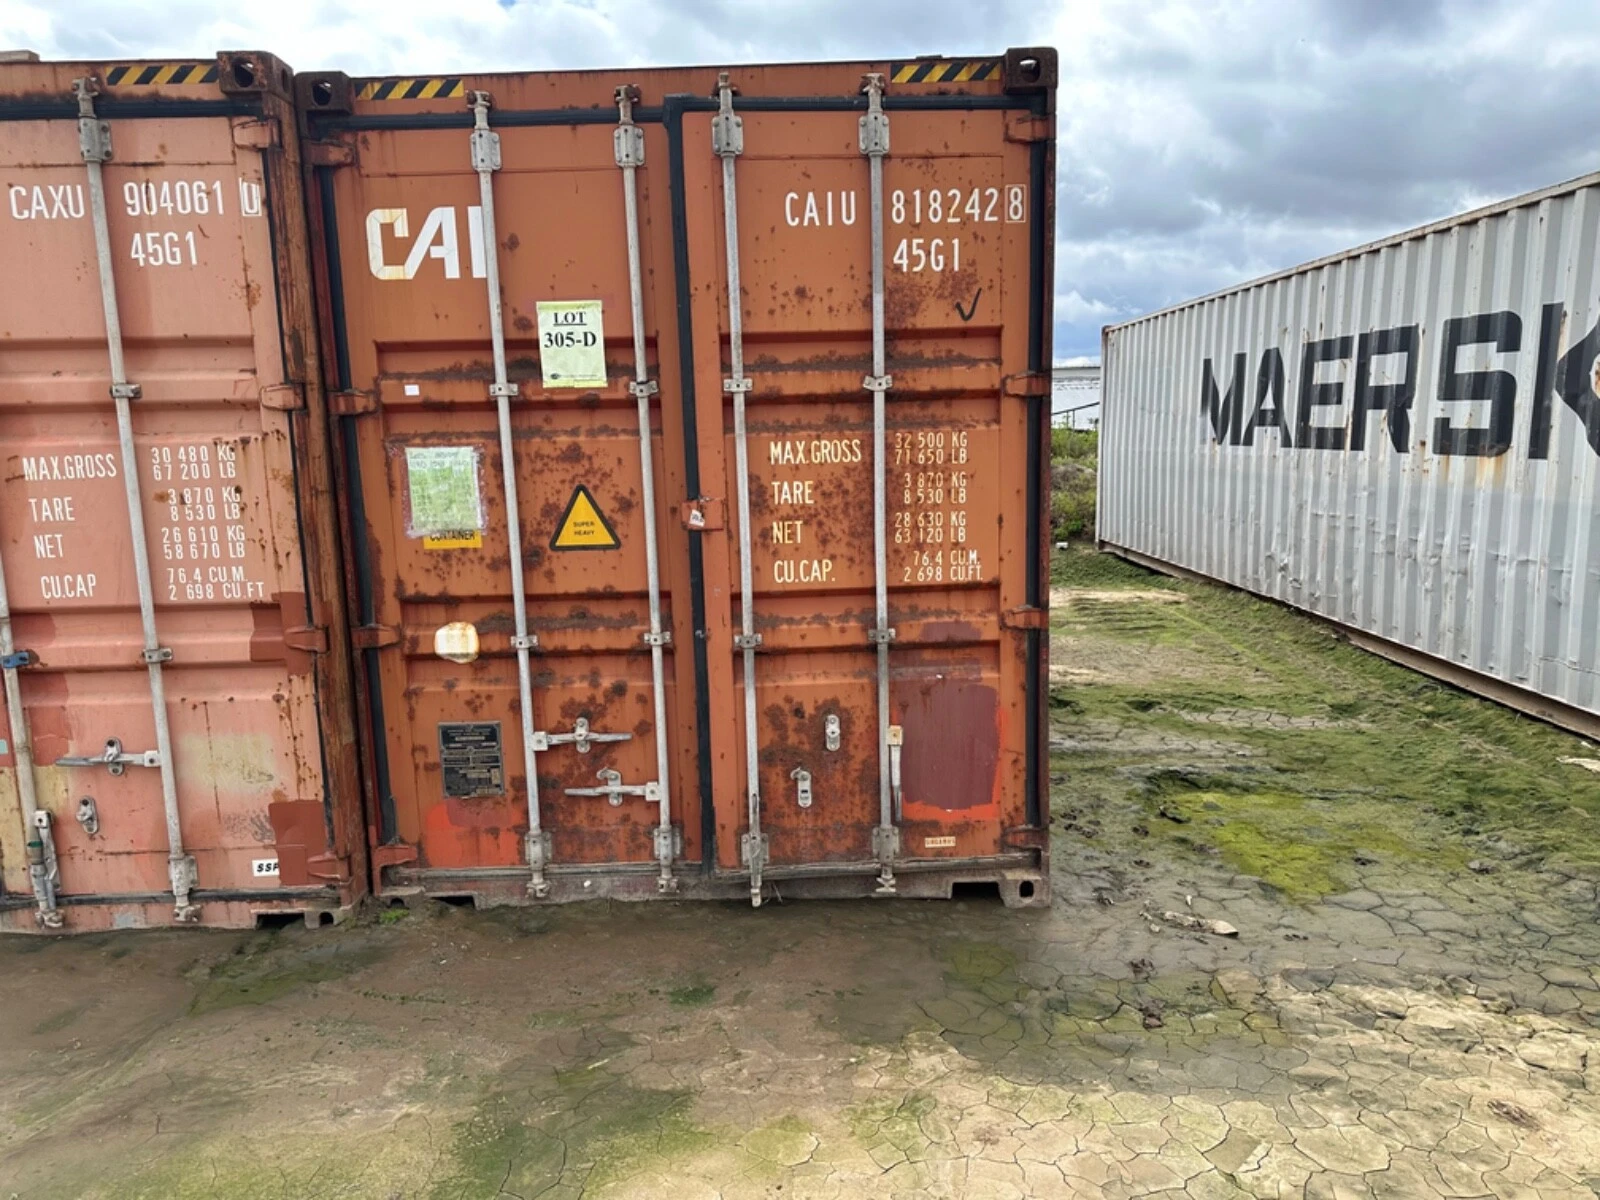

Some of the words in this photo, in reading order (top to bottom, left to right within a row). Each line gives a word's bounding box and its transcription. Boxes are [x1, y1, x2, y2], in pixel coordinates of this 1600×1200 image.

[9, 185, 85, 219] CAXU
[123, 181, 224, 216] 904061
[785, 190, 856, 227] CAIU
[891, 187, 999, 225] 818242
[1009, 186, 1023, 221] 8
[130, 231, 197, 266] 45G1
[366, 206, 487, 280] CAI
[892, 237, 960, 272] 45G1
[553, 310, 587, 325] LOT
[543, 331, 597, 349] 305-D
[895, 433, 912, 449] 32
[918, 432, 944, 448] 500
[951, 431, 968, 447] KG
[151, 447, 171, 464] 30
[178, 445, 208, 463] 480
[217, 444, 236, 461] KG
[770, 439, 862, 465] MAX.GROSS
[895, 448, 911, 465] 71
[918, 448, 944, 464] 650
[951, 447, 967, 464] LB
[22, 453, 117, 481] MAX.GROSS
[153, 464, 172, 481] 67
[180, 463, 210, 480] 200
[219, 461, 236, 478] LB
[904, 472, 912, 488] 3
[917, 471, 943, 488] 870
[951, 471, 967, 487] KG
[167, 488, 177, 505] 3
[183, 487, 213, 504] 870
[222, 486, 241, 502] KG
[771, 480, 815, 505] TARE
[904, 488, 912, 504] 8
[917, 488, 943, 504] 530
[950, 487, 966, 504] LB
[28, 497, 75, 522] TARE
[170, 505, 179, 522] 8
[185, 504, 215, 521] 530
[224, 502, 241, 519] LB
[894, 511, 911, 528] 28
[917, 511, 944, 527] 630
[950, 510, 966, 527] KG
[161, 526, 182, 544] 26
[188, 525, 218, 542] 610
[226, 524, 246, 541] KG
[772, 520, 803, 544] NET
[894, 528, 911, 544] 63
[919, 527, 944, 543] 120
[950, 527, 966, 542] LB
[34, 534, 63, 559] NET
[163, 543, 184, 560] 58
[189, 542, 220, 559] 670
[228, 541, 246, 558] LB
[913, 550, 943, 566] 76.4
[773, 559, 836, 583] CU.CAP.
[904, 566, 912, 582] 2
[917, 566, 943, 582] 698
[40, 574, 96, 599] CU.CAP
[168, 584, 178, 601] 2
[186, 583, 214, 600] 698
